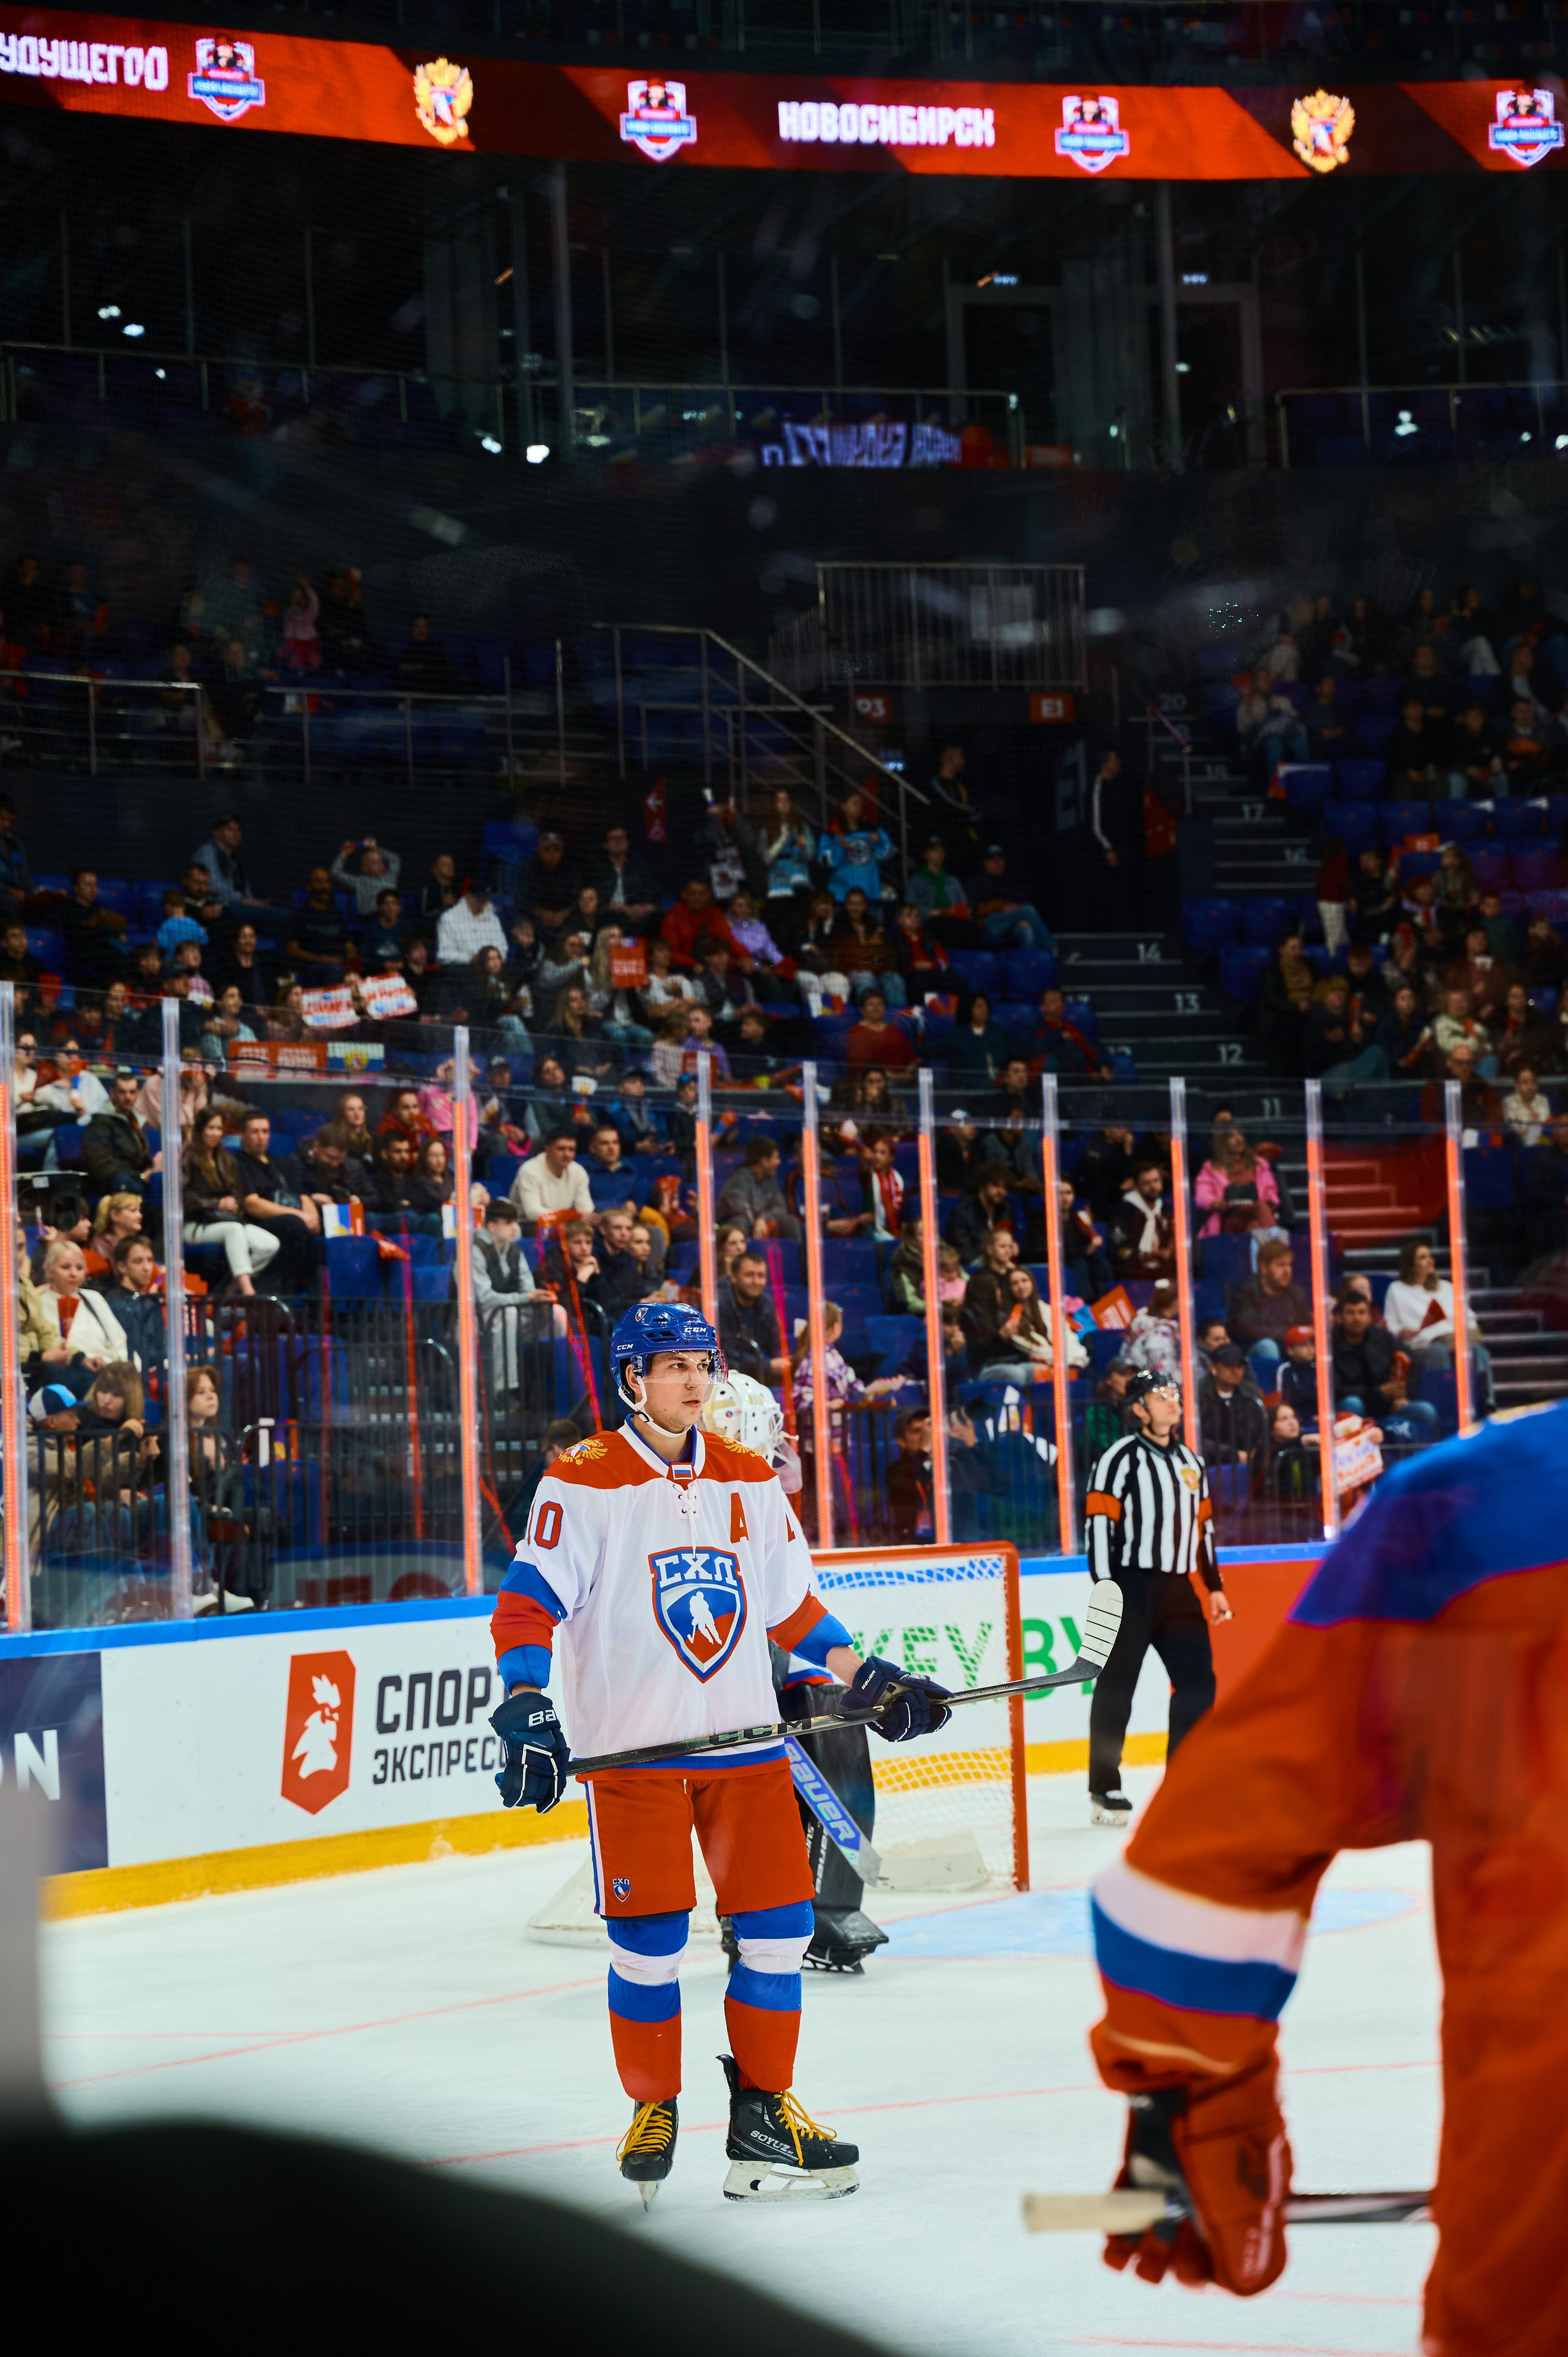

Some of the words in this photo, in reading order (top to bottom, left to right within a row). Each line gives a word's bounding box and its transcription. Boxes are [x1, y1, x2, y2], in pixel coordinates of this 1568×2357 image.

[778, 101, 995, 148] НОВОСИБИРСК
[1041, 698, 1065, 719] E1
[1241, 803, 1265, 820] 17
[1137, 941, 1162, 964] 14
[1173, 992, 1200, 1014] 13
[1218, 1043, 1243, 1063] 12
[1261, 1098, 1282, 1118] 11
[730, 1492, 749, 1544] A
[654, 1552, 739, 1588] СХЛ
[862, 1670, 876, 1690] BAUER
[376, 1667, 510, 1735] СПОР
[709, 1718, 812, 1746] CCM
[750, 2130, 790, 2152] SOYUZ
